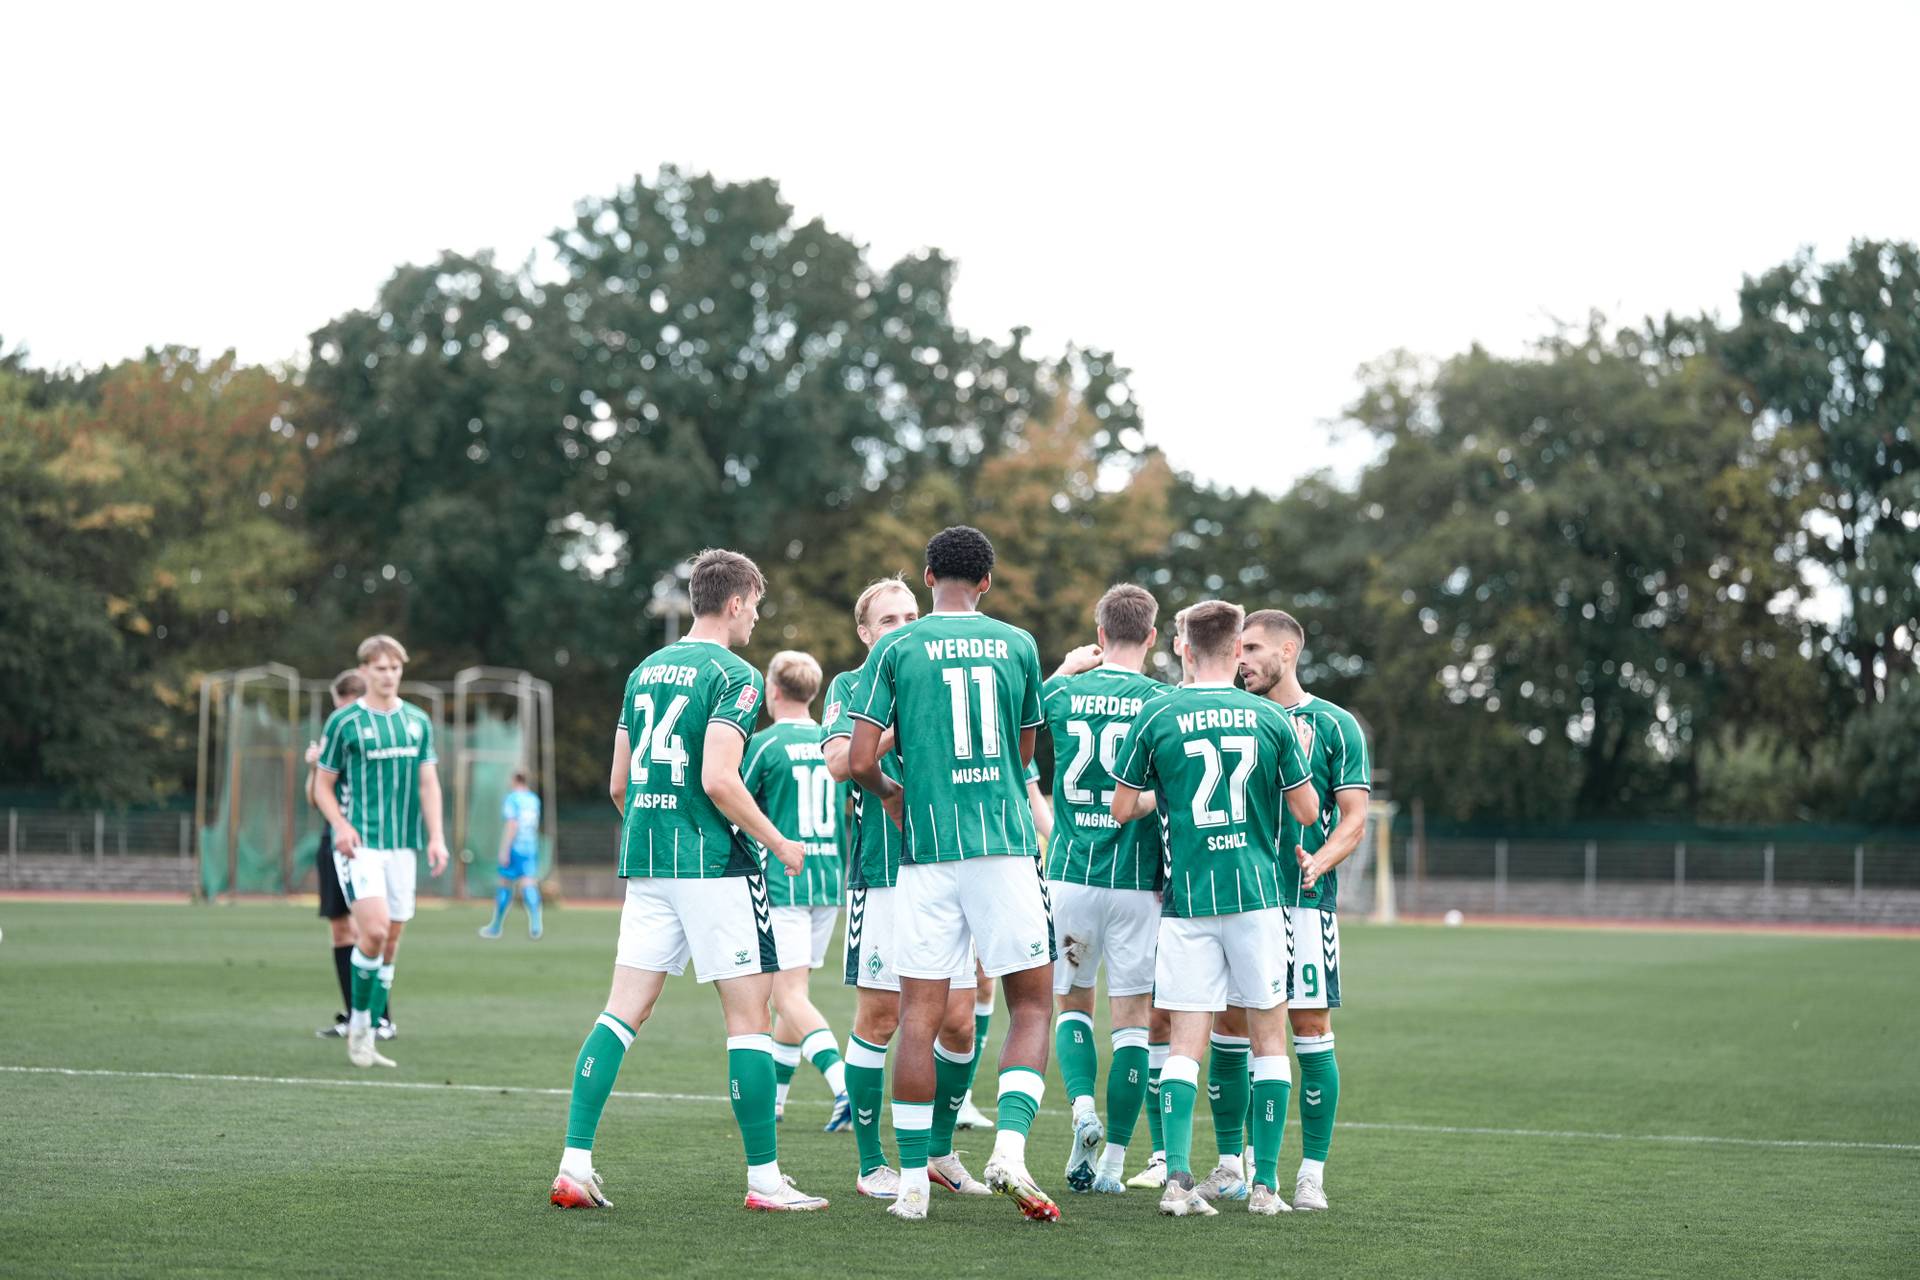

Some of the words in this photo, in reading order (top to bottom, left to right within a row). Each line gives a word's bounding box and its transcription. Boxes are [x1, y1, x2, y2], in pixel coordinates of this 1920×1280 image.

[924, 638, 1009, 661] WERDER
[639, 664, 698, 688] WERDER
[942, 666, 1000, 760] 11
[1070, 694, 1143, 717] WERDER
[1176, 708, 1258, 734] WERDER
[630, 693, 690, 787] 24
[784, 742, 826, 761] WER
[951, 766, 1000, 785] MUSAH
[1183, 736, 1259, 829] 27
[792, 765, 836, 838] 10
[1302, 963, 1319, 998] 9
